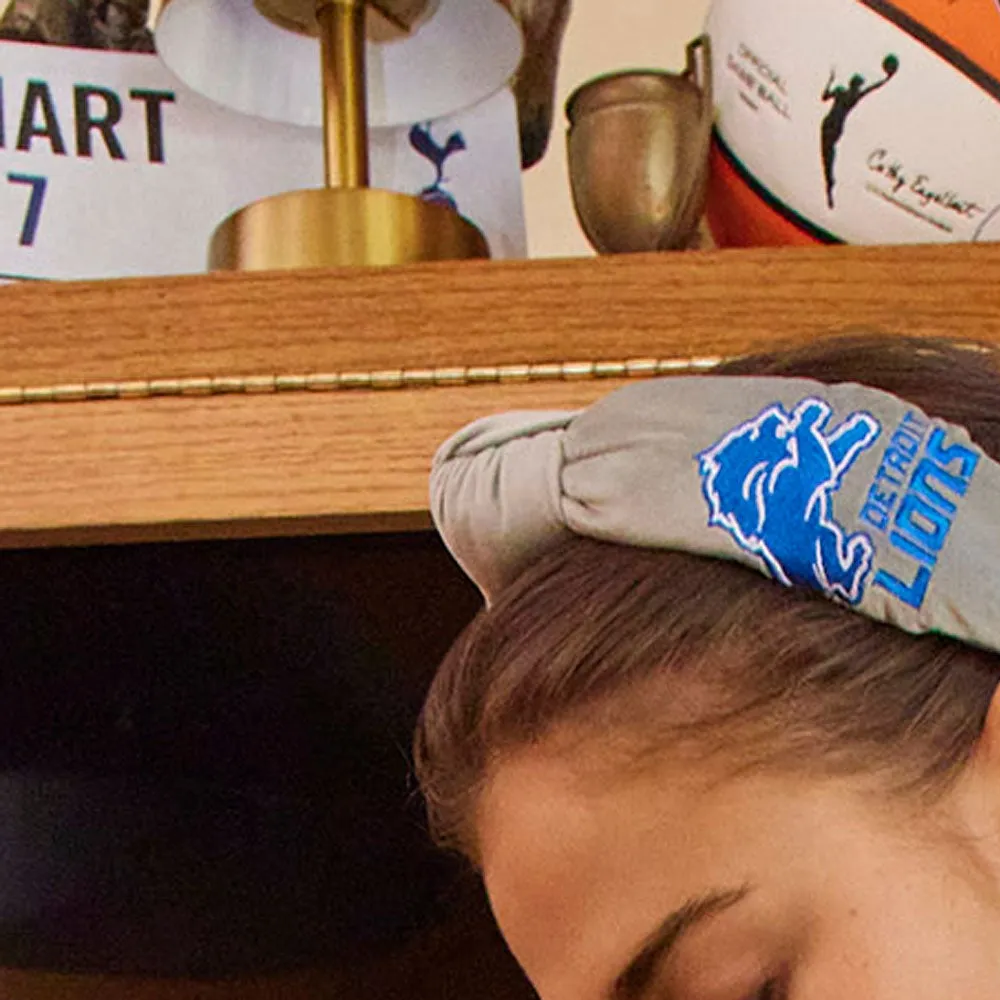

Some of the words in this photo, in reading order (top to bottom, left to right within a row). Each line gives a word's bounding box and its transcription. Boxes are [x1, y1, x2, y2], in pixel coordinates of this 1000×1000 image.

[0, 76, 175, 164] ART
[858, 410, 928, 533] DETROIT
[873, 427, 981, 611] LIONS
